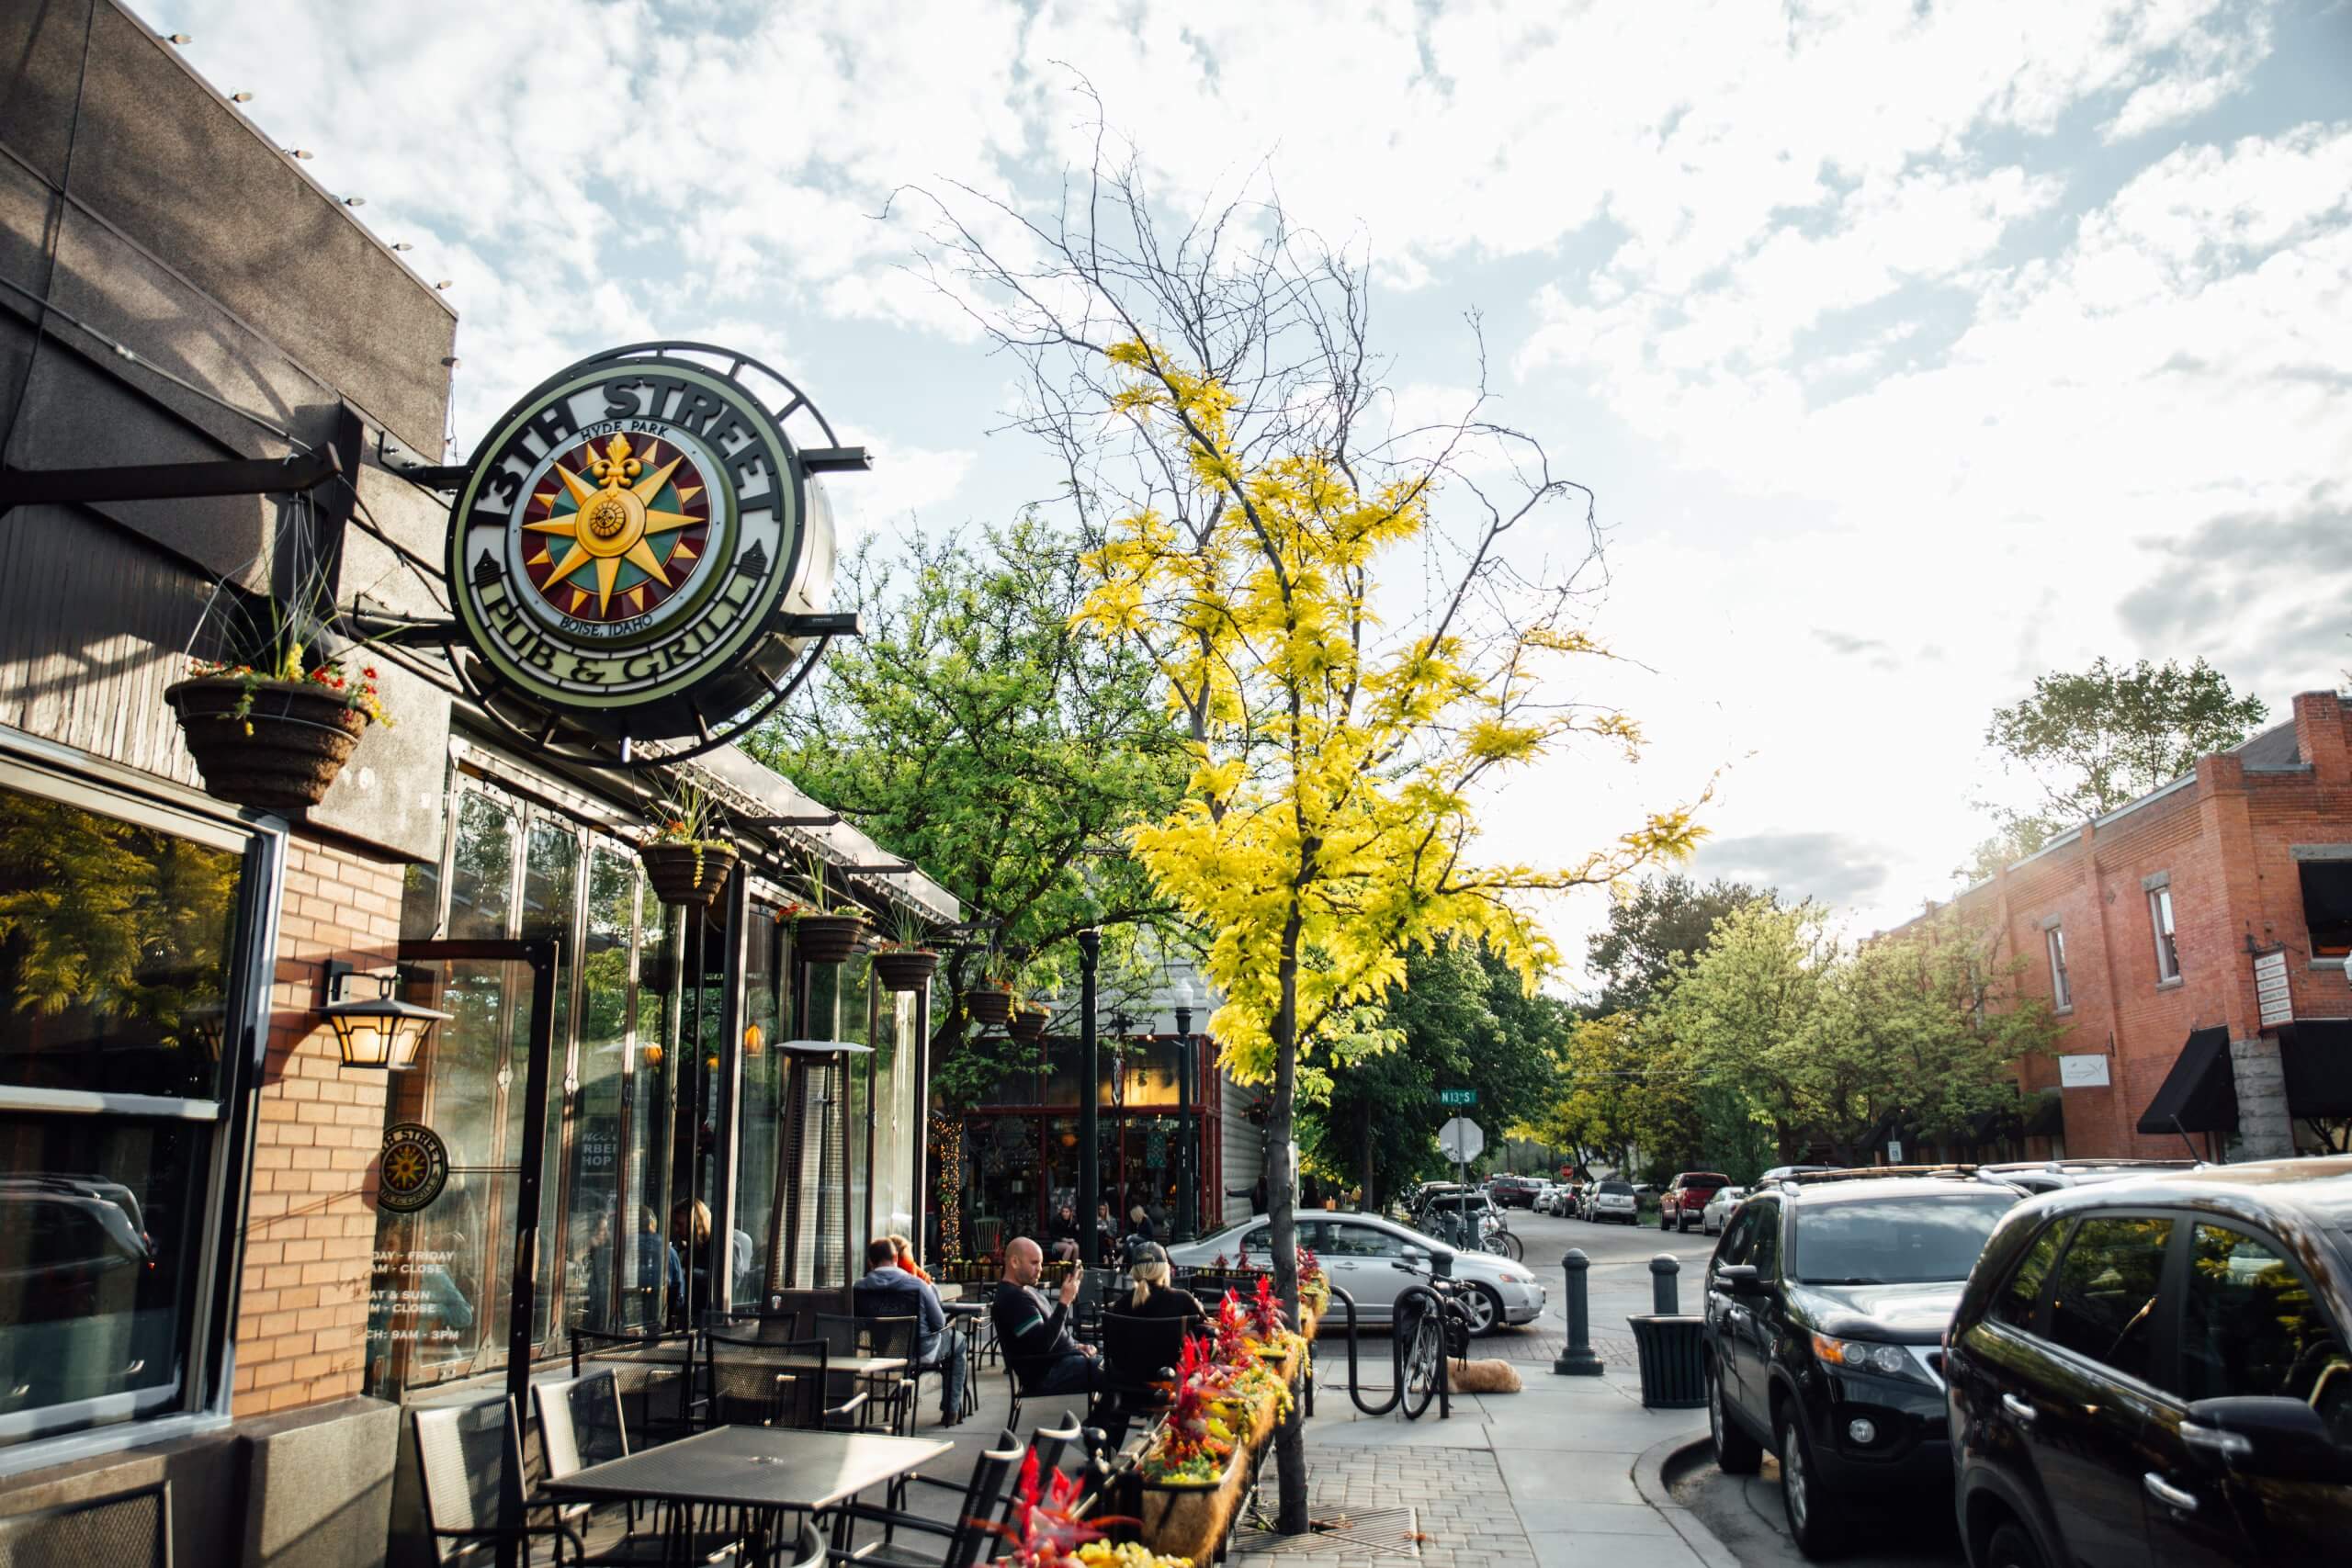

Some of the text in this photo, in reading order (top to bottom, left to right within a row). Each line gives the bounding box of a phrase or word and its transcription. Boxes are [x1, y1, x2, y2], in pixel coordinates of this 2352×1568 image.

[581, 422, 669, 441] HYDE PARK
[468, 378, 781, 532] 13TH STREET
[560, 615, 652, 637] BOISE, IDAHO
[484, 584, 757, 682] PUB & GRILL
[1442, 1092, 1449, 1102] N
[583, 1144, 616, 1154] RBE
[582, 1156, 611, 1166] HOP
[372, 1251, 396, 1260] DAY
[408, 1251, 455, 1260] FRIDAY
[372, 1264, 389, 1273] AM
[400, 1264, 443, 1273] CLOSE
[370, 1291, 430, 1300] AT & SUN
[369, 1304, 379, 1313] M
[392, 1303, 436, 1314] CLOSE
[367, 1330, 387, 1339] CH:
[391, 1330, 418, 1339] 9AM
[432, 1330, 458, 1339] 3PM
